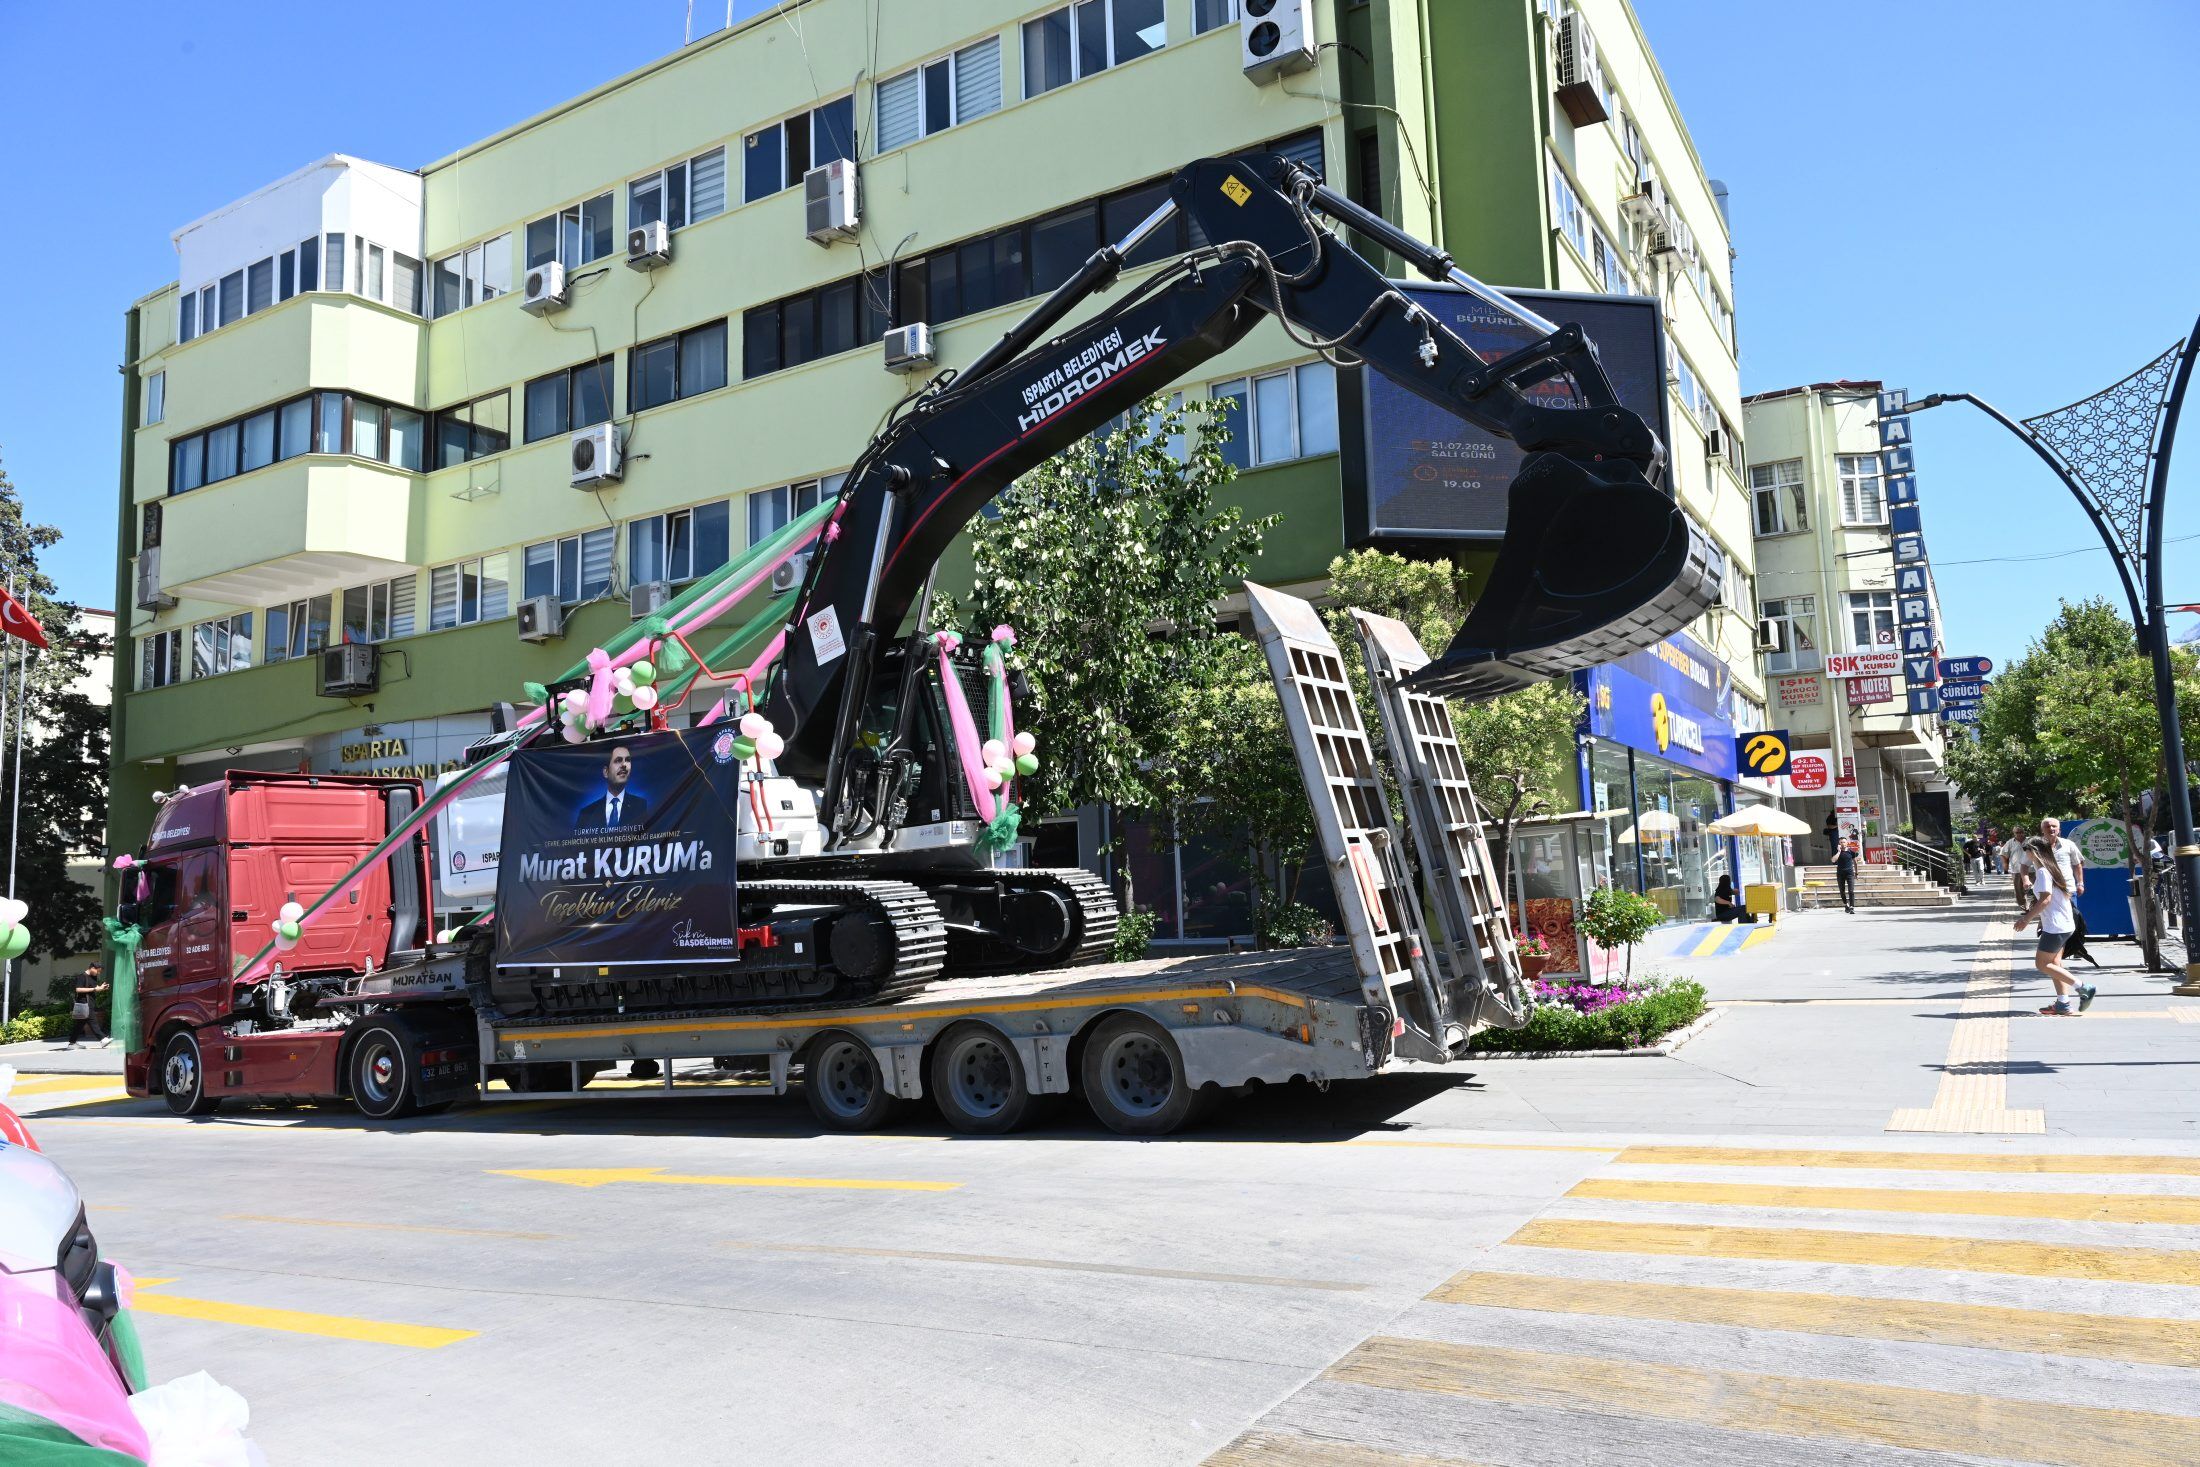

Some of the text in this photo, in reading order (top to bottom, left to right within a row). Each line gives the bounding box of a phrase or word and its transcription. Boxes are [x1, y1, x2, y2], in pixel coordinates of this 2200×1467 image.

[1021, 326, 1124, 406] ISPARTA BELEDİYESİ
[1431, 441, 1494, 451] 21.07.2026
[1431, 449, 1496, 459] SALI GÜNÜ
[1442, 480, 1481, 489] 19.00
[1883, 392, 1930, 712] HALI SARAYI
[1827, 652, 1899, 676] IŞIK SÜRÜCÜ
[1863, 662, 1896, 670] KURSU
[1950, 661, 1970, 676] IŞIK
[1780, 676, 1817, 687] IŞIK
[1849, 677, 1890, 695] 3. NOTER
[1780, 686, 1819, 695] SÜRÜCÜ
[1781, 692, 1819, 701] KURSU
[1942, 683, 1980, 698] SÜRÜCÜ
[341, 738, 407, 763] ISPARTA
[167, 824, 191, 839] BELEDİYESİ
[574, 826, 599, 836] TÜRKİYE
[590, 836, 598, 844] VE
[598, 835, 614, 843] İKLİM
[518, 850, 588, 883] Murat
[540, 885, 682, 922] Teşekkür Ederiz
[679, 936, 734, 948] BAŞDEĞİRMEN
[150, 945, 172, 957] BELEDİYESİ
[392, 972, 452, 986] MURATSAN
